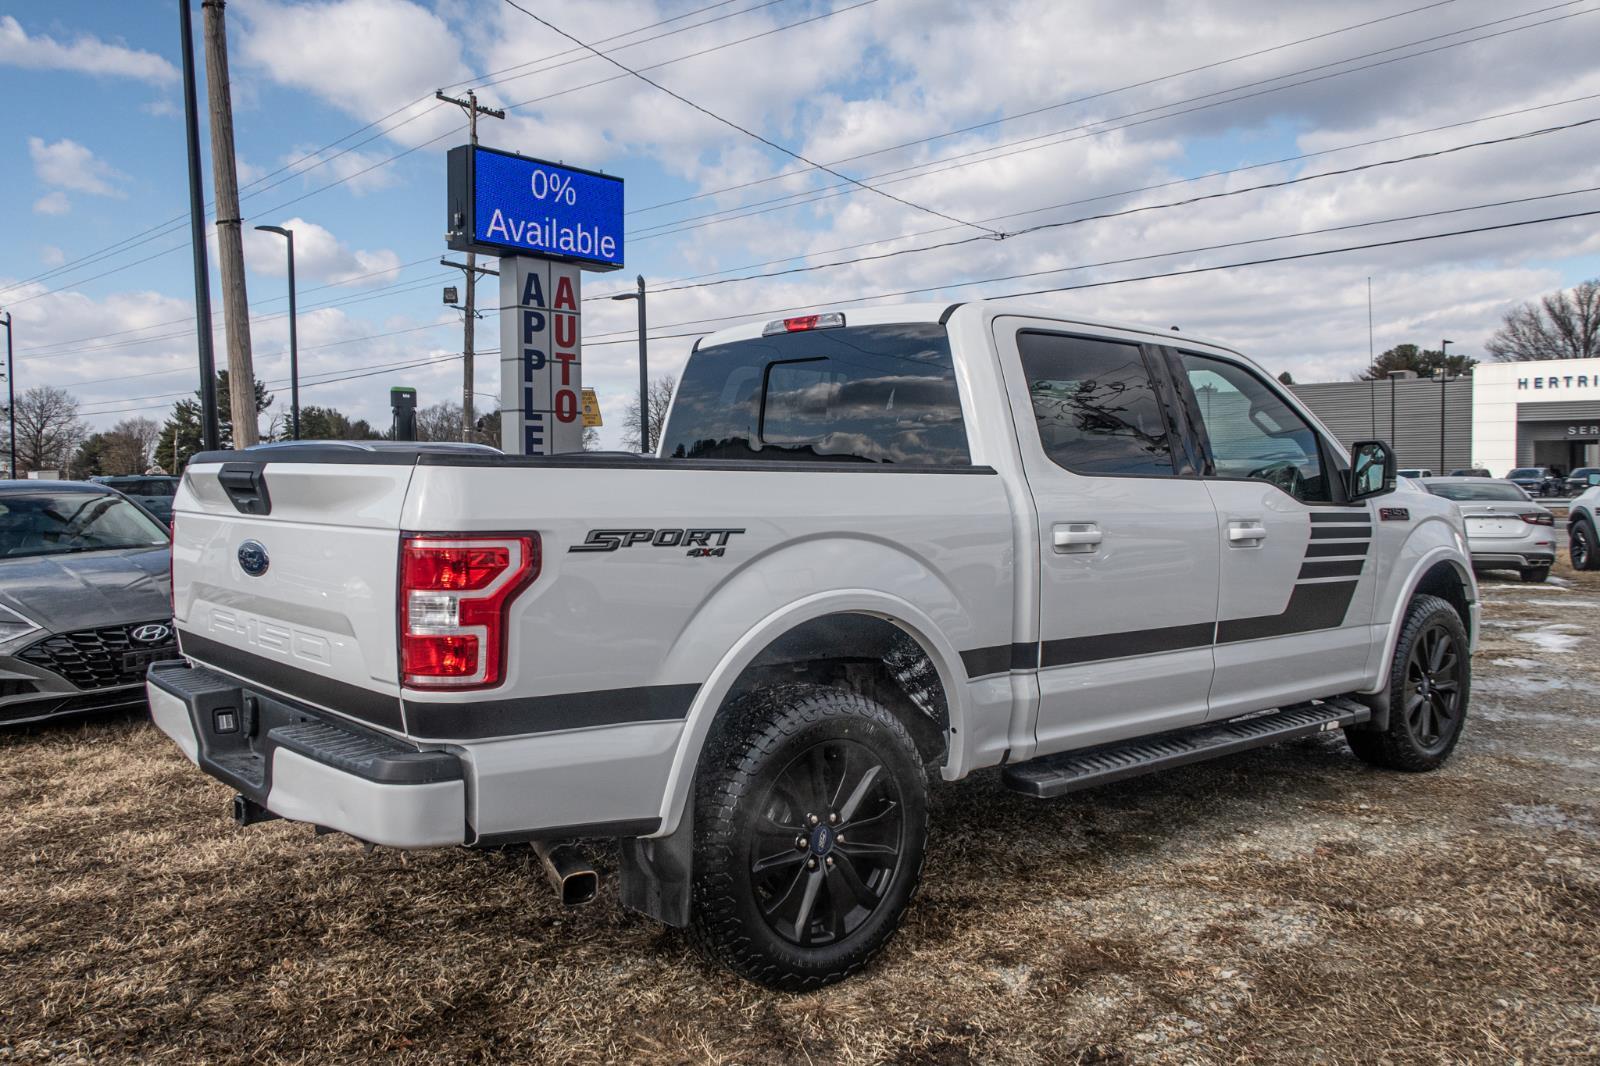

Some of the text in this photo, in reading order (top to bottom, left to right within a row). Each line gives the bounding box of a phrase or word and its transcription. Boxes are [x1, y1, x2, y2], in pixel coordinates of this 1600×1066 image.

[531, 169, 576, 206] 0%
[486, 208, 616, 258] Available
[521, 272, 546, 455] APPLE
[553, 276, 578, 424] AUTO
[1517, 375, 1599, 389] HERTRI
[567, 528, 746, 554] SPORT
